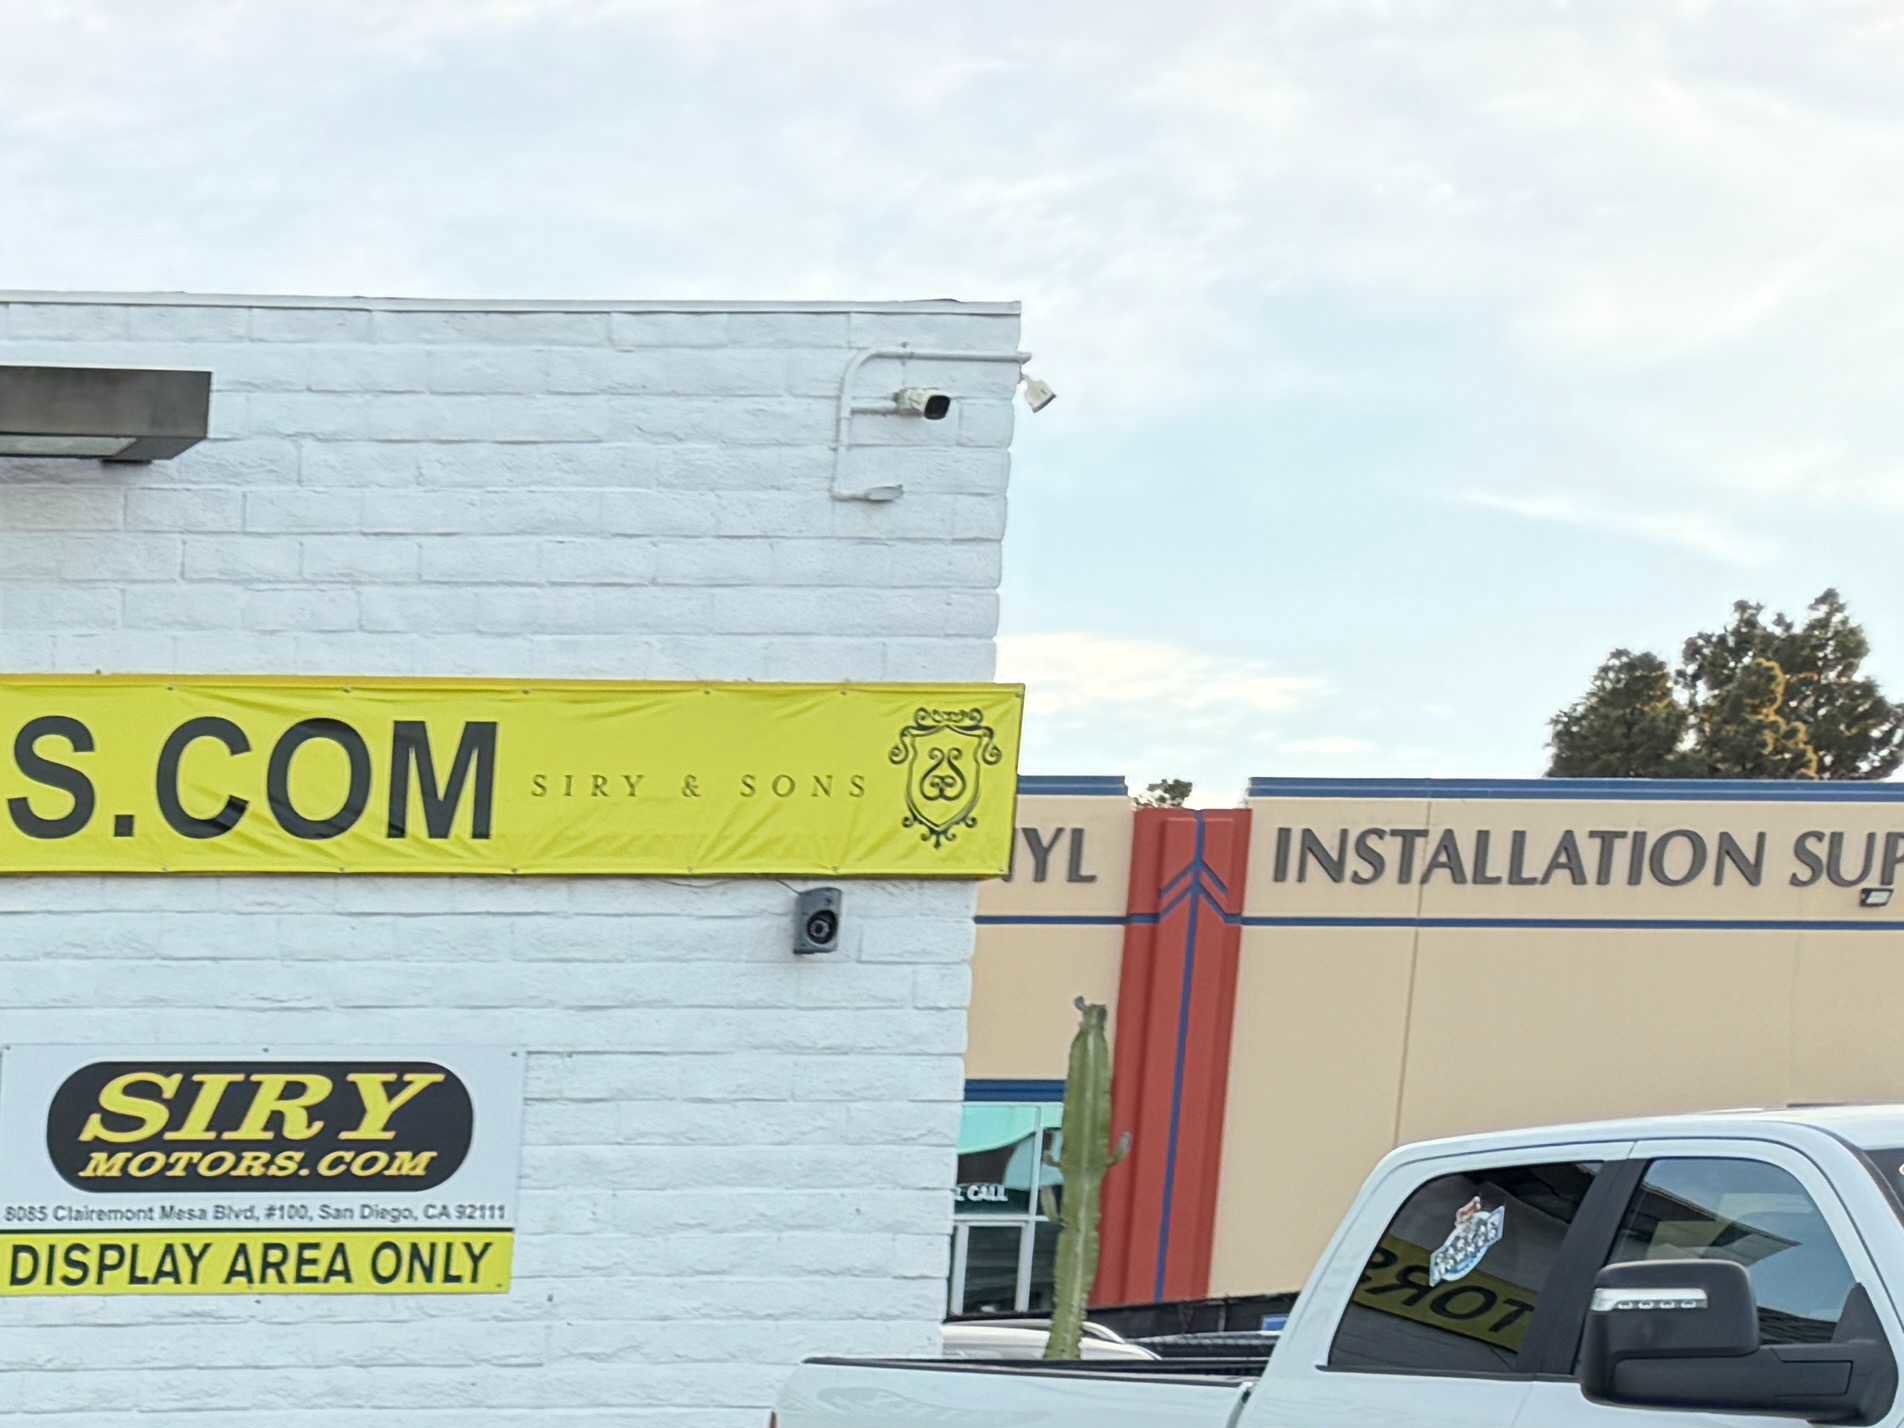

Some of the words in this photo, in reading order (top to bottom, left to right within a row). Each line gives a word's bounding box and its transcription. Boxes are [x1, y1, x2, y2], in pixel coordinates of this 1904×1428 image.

[532, 770, 644, 799] SIRY
[681, 770, 704, 799] &
[741, 770, 869, 799] SONS
[1273, 826, 1767, 887] INSTALLATION
[77, 1071, 446, 1143] SIRY
[77, 1150, 438, 1178] MOTORS.COM
[4, 1205, 48, 1222] 8085
[52, 1205, 154, 1222] Clairemont
[159, 1205, 208, 1221] Mesa
[212, 1204, 260, 1224] Blvd,
[264, 1204, 314, 1222] #100,
[318, 1204, 355, 1220] San
[359, 1204, 419, 1223] Diego,
[423, 1204, 453, 1220] CA
[455, 1204, 506, 1220] 92111
[8, 1242, 213, 1287] DISPLAY
[222, 1241, 354, 1286] AREA
[369, 1240, 494, 1285] ONLY
